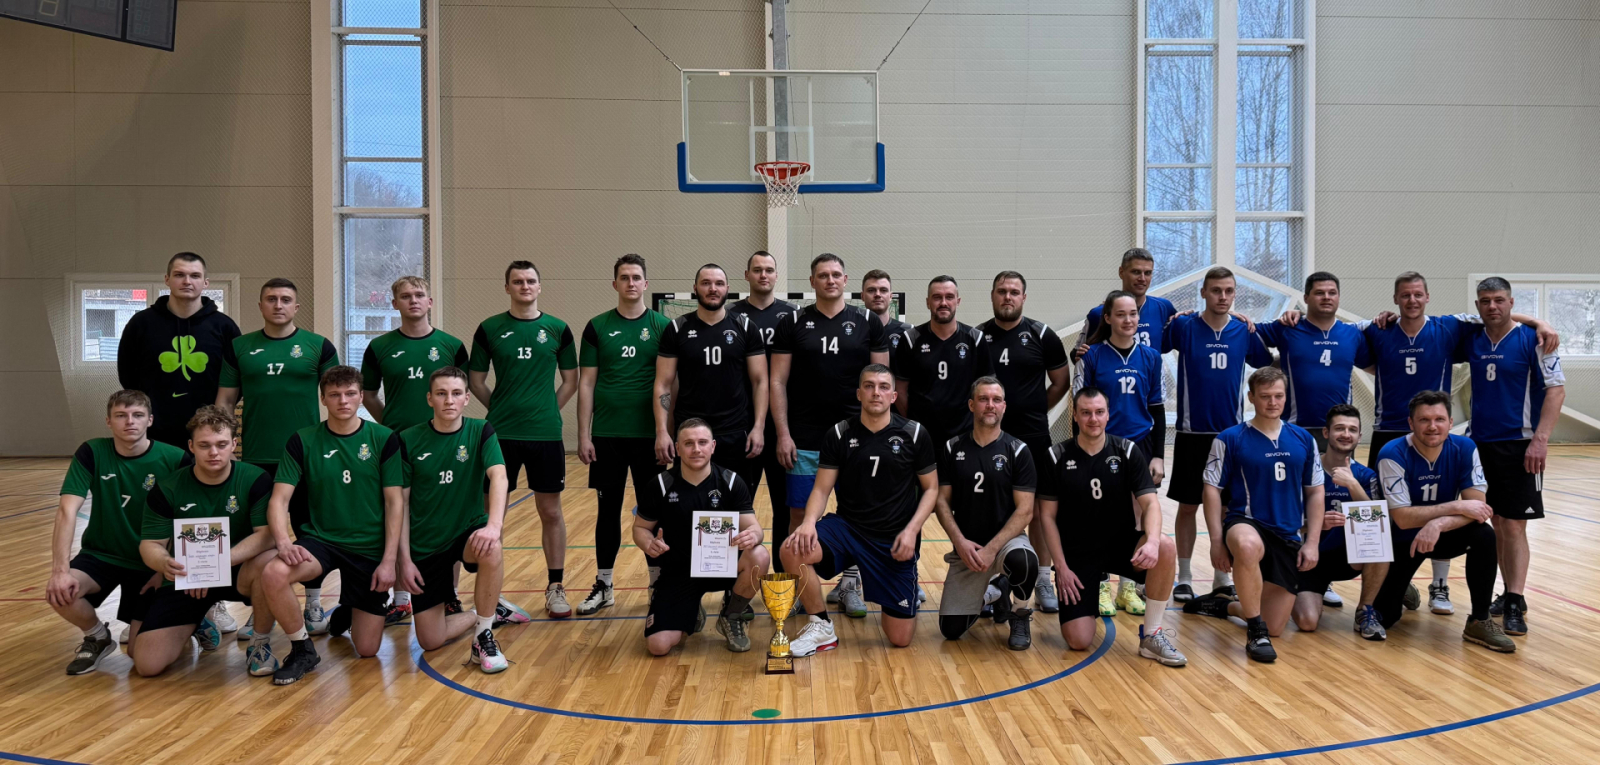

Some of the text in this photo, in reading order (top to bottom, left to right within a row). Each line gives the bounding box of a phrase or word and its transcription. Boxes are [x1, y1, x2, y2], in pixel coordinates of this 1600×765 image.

[759, 327, 775, 345] 12
[820, 336, 839, 354] 14
[1134, 331, 1151, 347] 13
[517, 347, 533, 360] 13
[621, 346, 636, 358] 20
[703, 345, 722, 366] 10
[999, 348, 1010, 366] 4
[1208, 352, 1228, 370] 10
[1319, 349, 1332, 367] 4
[266, 363, 285, 375] 17
[407, 367, 424, 380] 14
[937, 361, 949, 381] 9
[1405, 357, 1418, 376] 5
[1486, 363, 1497, 382] 8
[1118, 376, 1137, 395] 12
[869, 455, 881, 478] 7
[1273, 461, 1287, 482] 6
[342, 469, 352, 484] 8
[438, 470, 454, 485] 18
[973, 471, 985, 494] 2
[1090, 477, 1103, 500] 8
[1420, 483, 1440, 503] 11
[121, 494, 132, 508] 7
